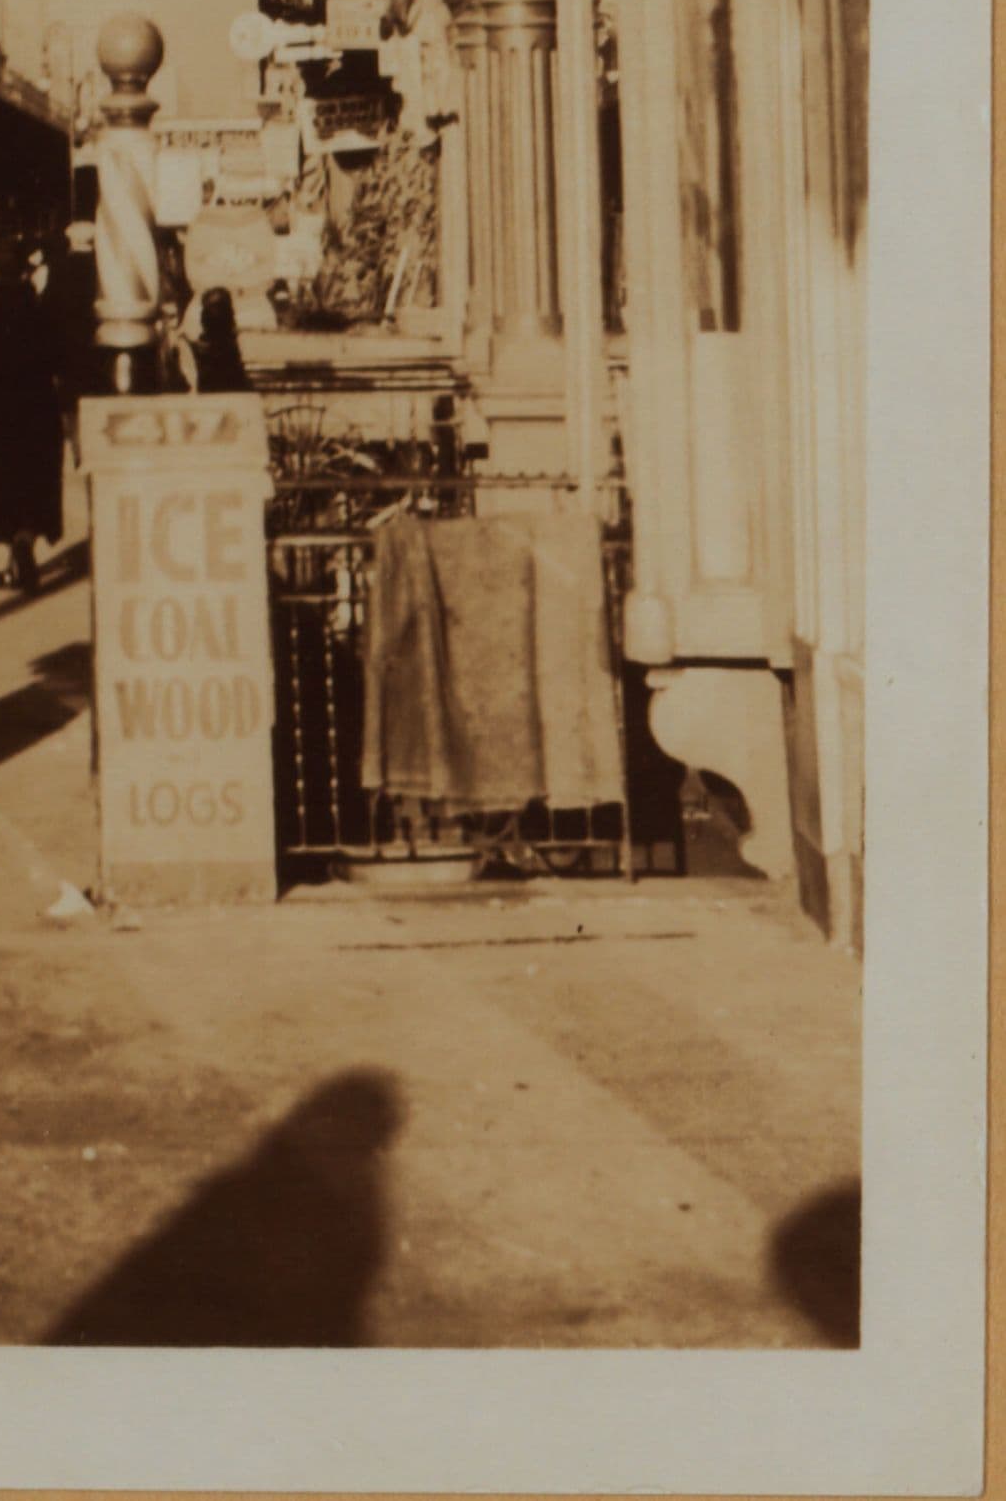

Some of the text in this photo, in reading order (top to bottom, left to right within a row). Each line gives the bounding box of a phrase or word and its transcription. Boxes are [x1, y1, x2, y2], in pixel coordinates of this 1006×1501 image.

[116, 489, 246, 584] ICE
[119, 595, 246, 662] COAL
[114, 675, 261, 741] WOOD
[129, 781, 245, 827] LOGS
